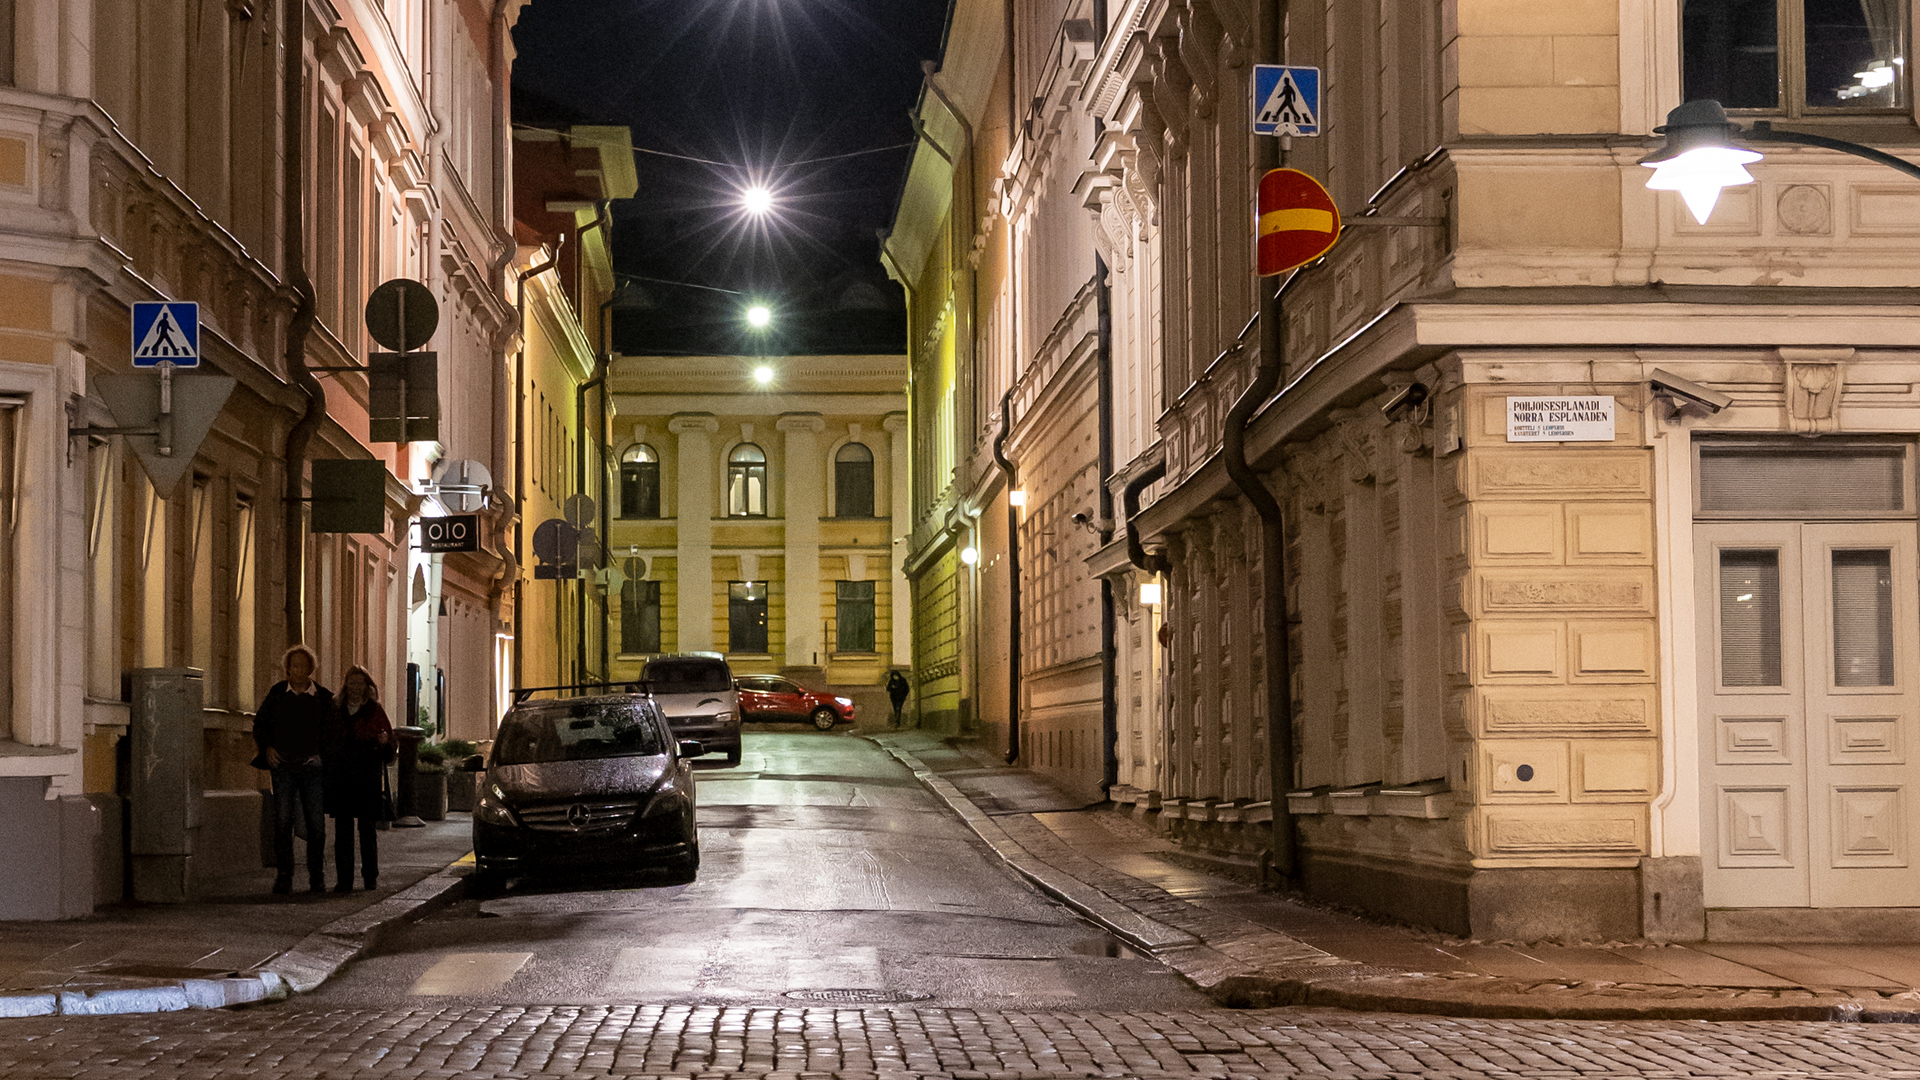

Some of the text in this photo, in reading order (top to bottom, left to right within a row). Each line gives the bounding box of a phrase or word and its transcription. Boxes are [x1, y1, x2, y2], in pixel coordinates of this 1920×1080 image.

[1513, 401, 1600, 411] POHJOISESPLANADI
[1514, 411, 1608, 422] NORRA ESPLANADEN
